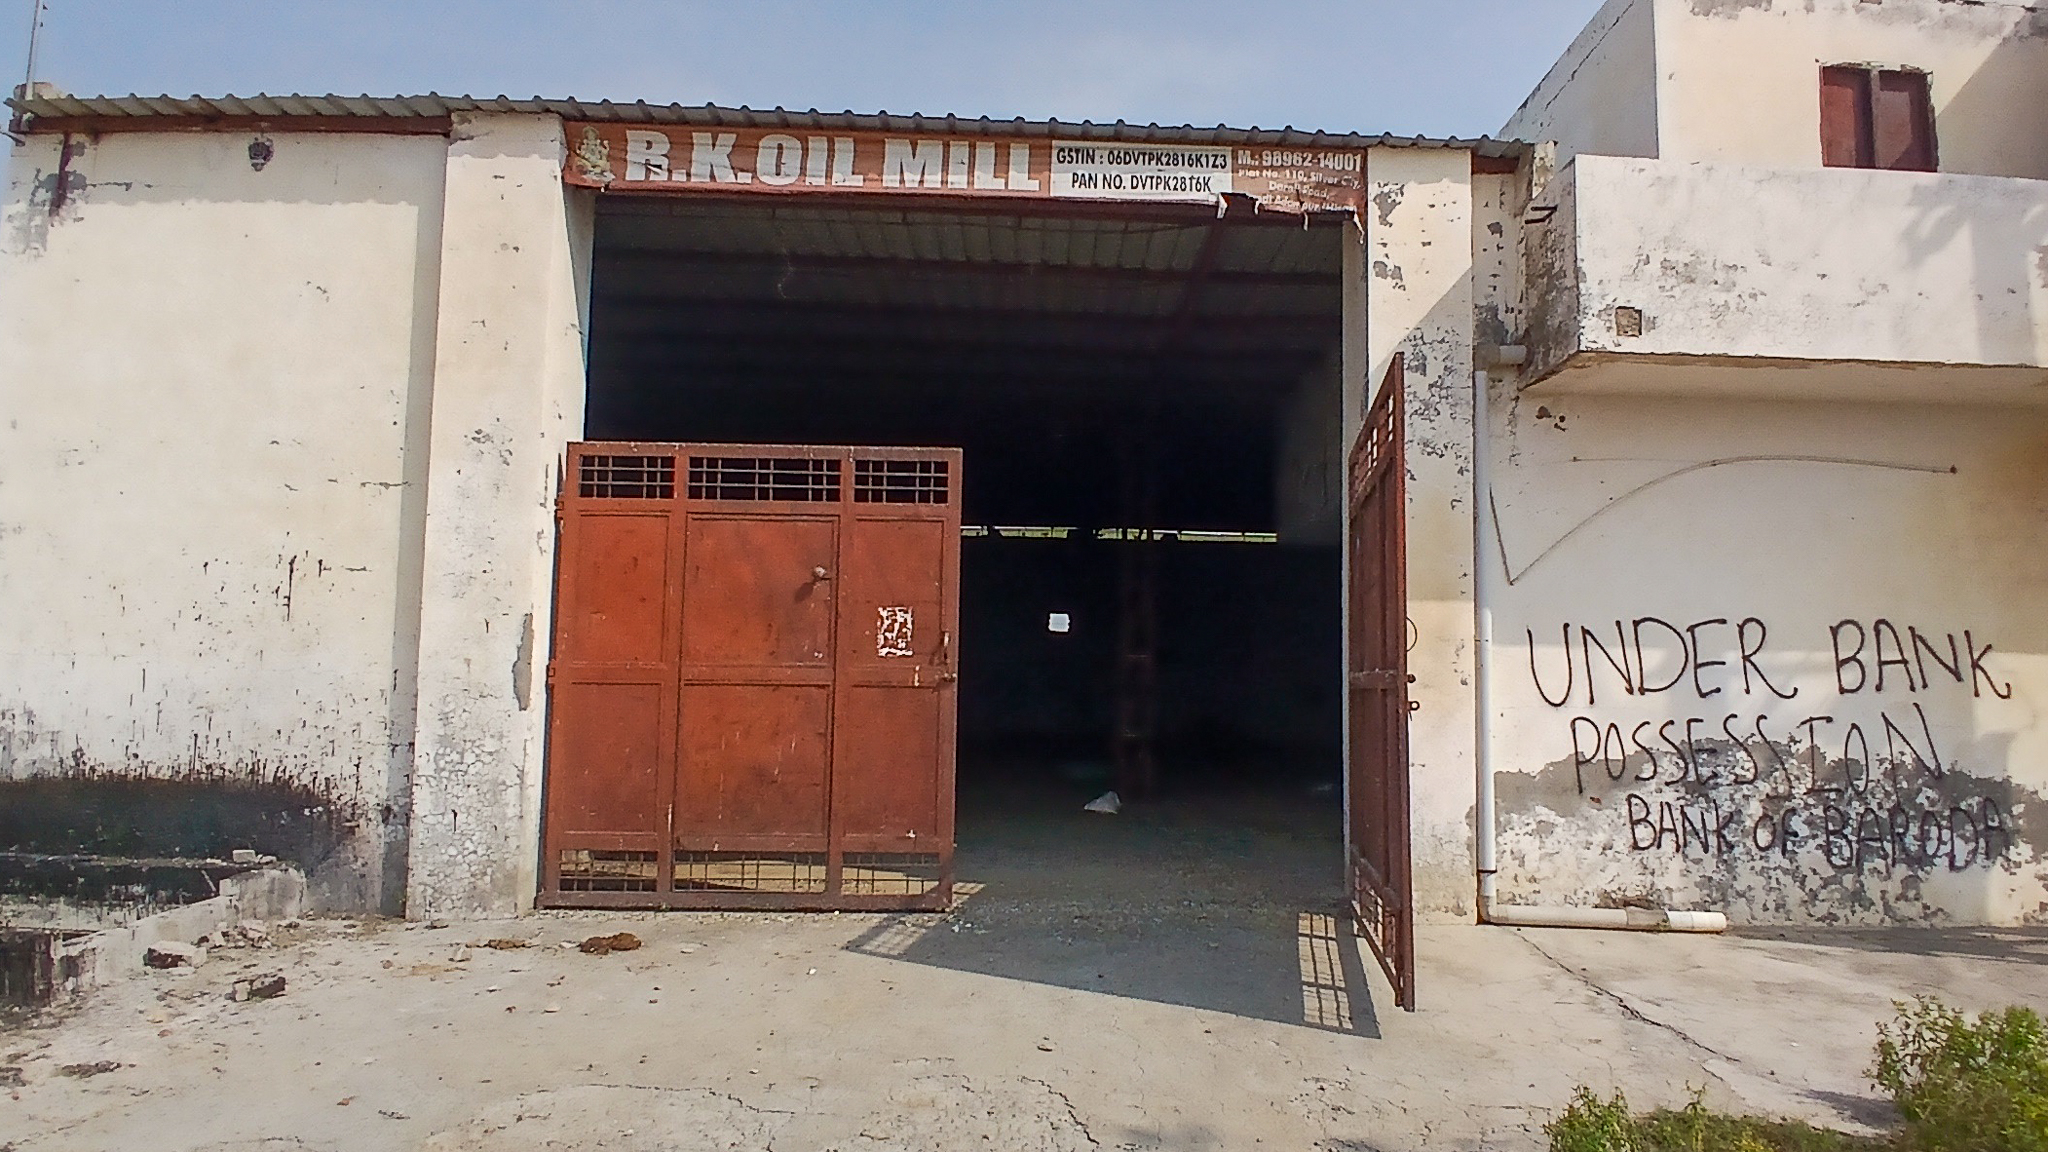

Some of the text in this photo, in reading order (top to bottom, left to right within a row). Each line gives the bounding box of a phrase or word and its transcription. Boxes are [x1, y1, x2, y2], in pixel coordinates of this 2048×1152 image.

[882, 138, 1040, 191] MILL
[1056, 148, 1096, 165] GSTIN
[1107, 151, 1228, 169] 06DVTPK2816K1Z3
[1071, 172, 1212, 193] PAN NO. DVTPK2816K
[1262, 150, 1361, 172] 98962-14001
[1526, 617, 2012, 707] UNDER BANK
[1570, 702, 1942, 794] POSSESSION
[1627, 793, 1735, 854] BANK
[1822, 797, 2010, 874] BARODA
